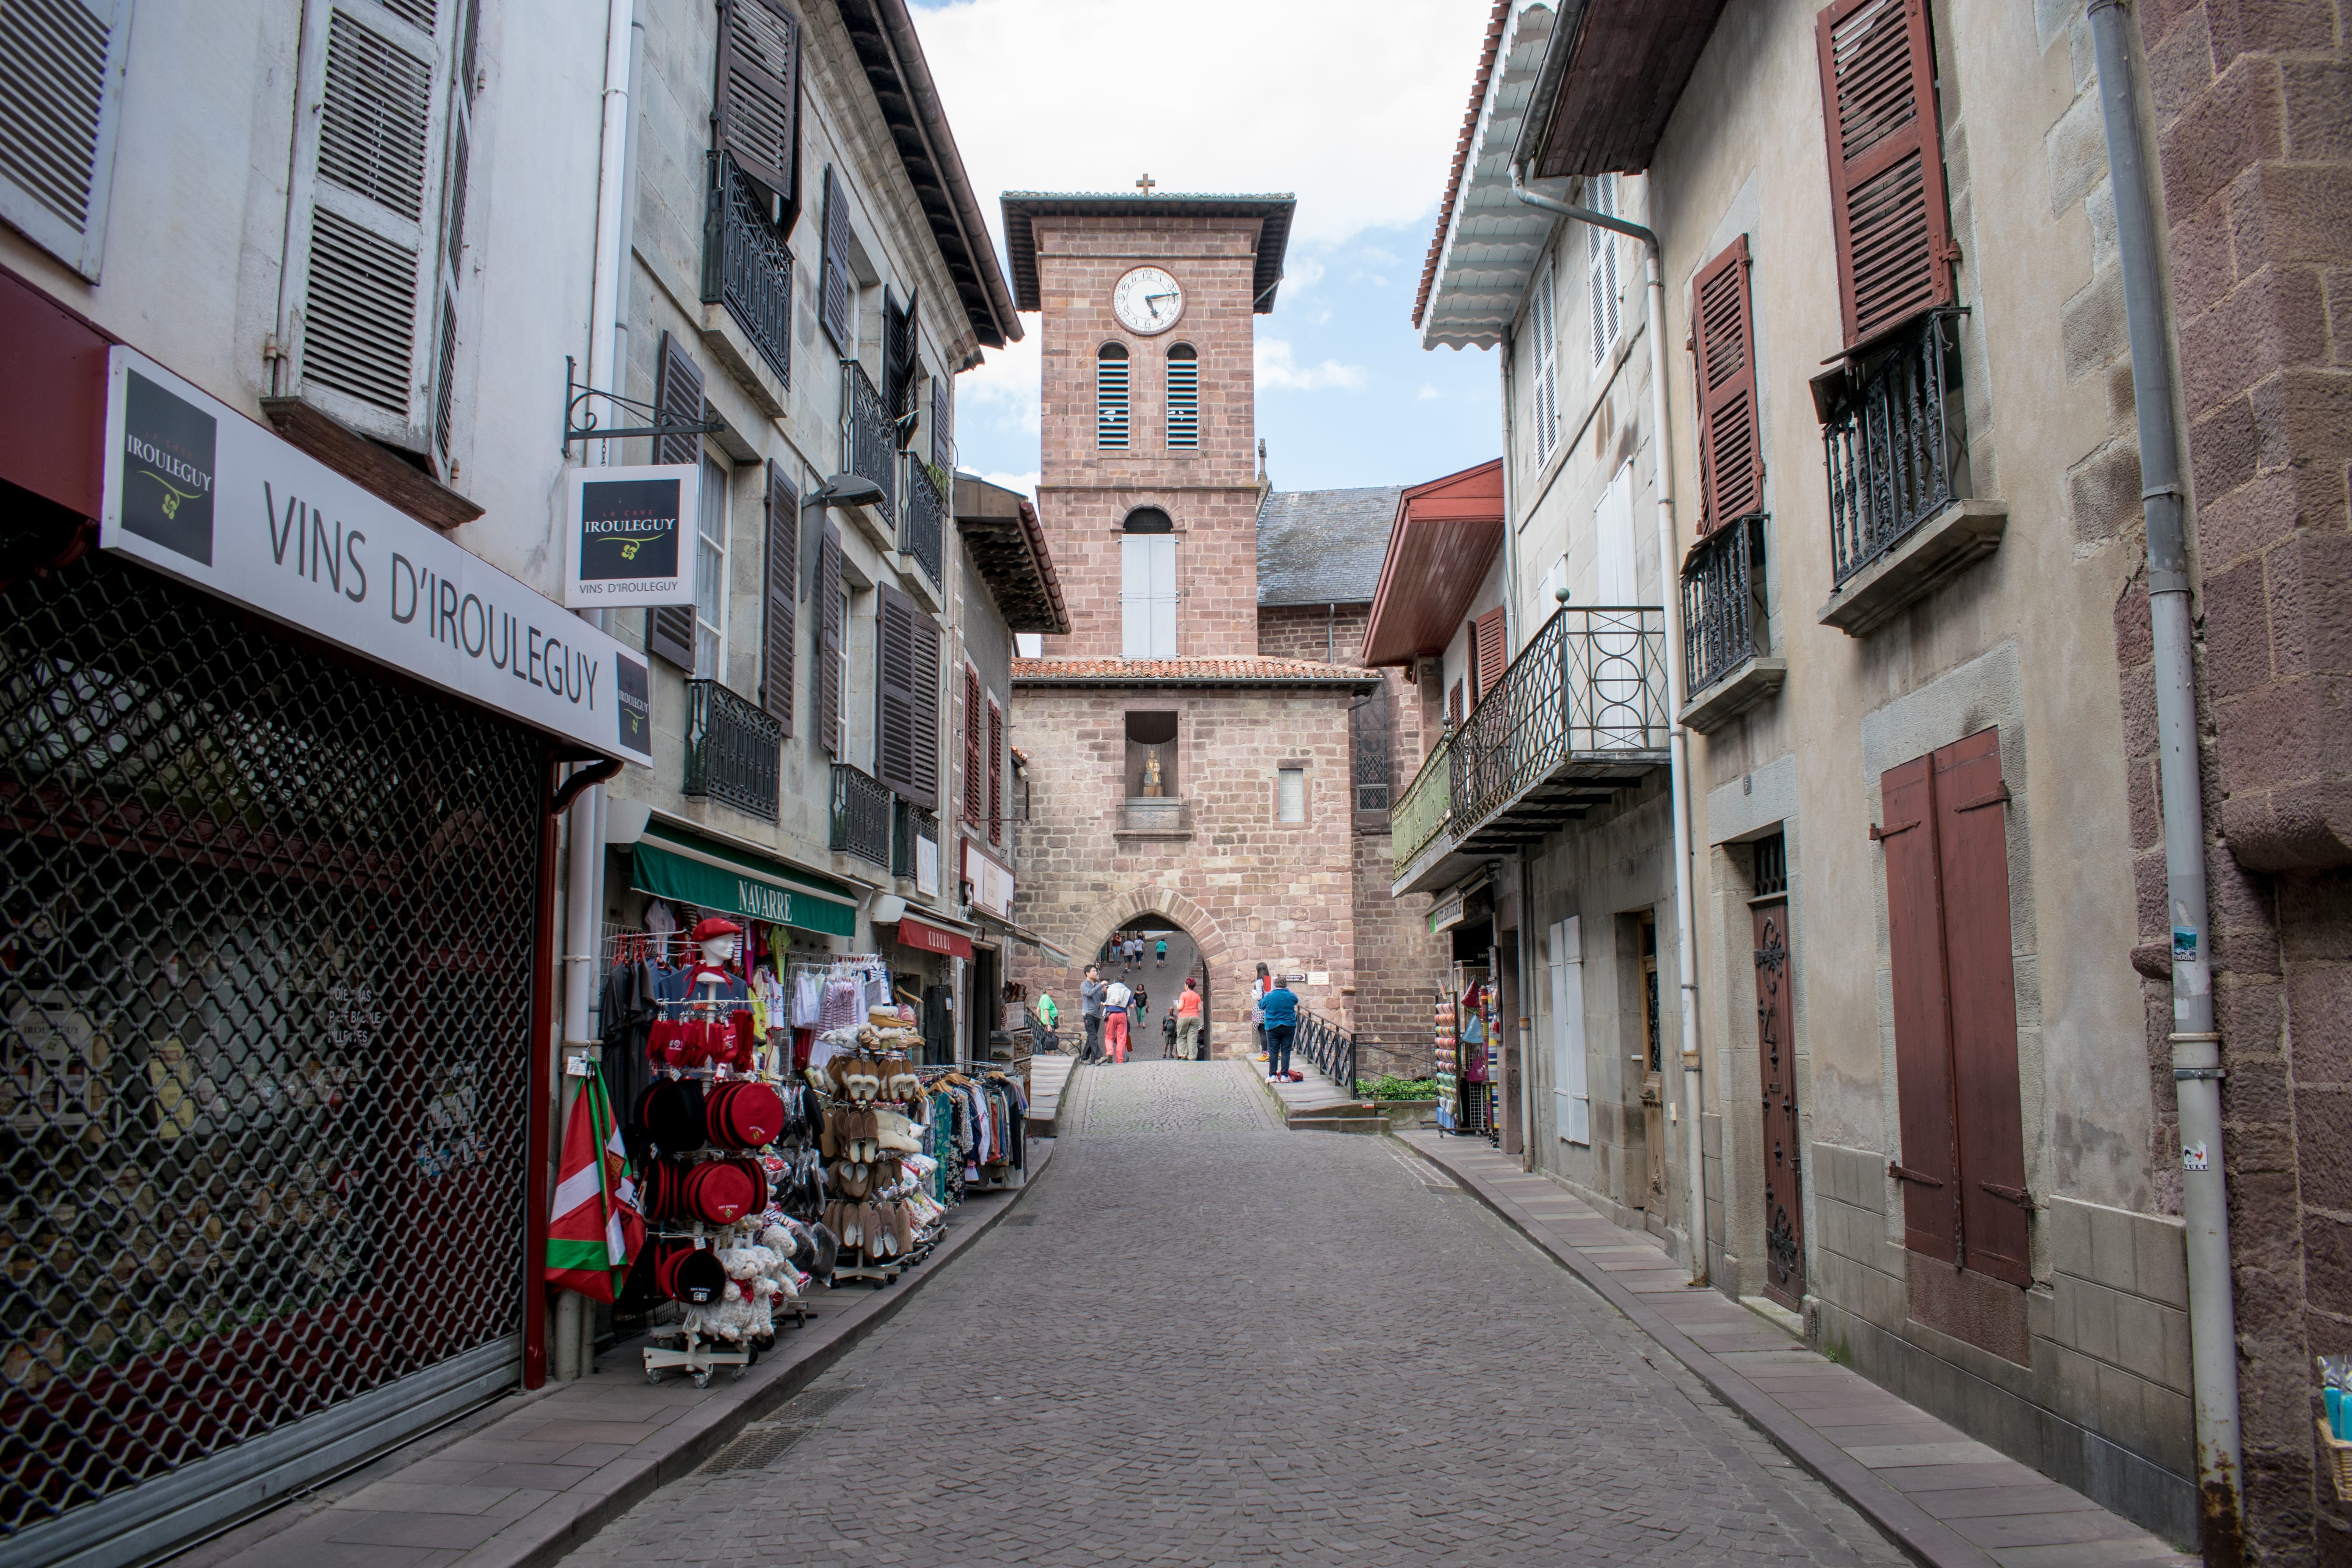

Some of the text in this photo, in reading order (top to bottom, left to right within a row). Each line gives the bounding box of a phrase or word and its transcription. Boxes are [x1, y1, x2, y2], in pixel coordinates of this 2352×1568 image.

[1131, 270, 1136, 283] 11
[1143, 270, 1153, 279] 12
[1121, 282, 1129, 290] 10
[1167, 283, 1174, 293] 2
[1118, 294, 1125, 304] 9
[1123, 306, 1129, 316] 8
[1144, 319, 1151, 328] 6
[127, 433, 213, 492] IROULEGUY
[584, 518, 676, 534] IROULEGUY
[579, 581, 679, 594] VINS D'IROULEGUY
[263, 480, 598, 711] VINS D'IROULEGUY
[618, 690, 648, 713] IROULEGUY
[738, 880, 792, 922] NAVARRE
[928, 931, 950, 950] KUXKUL
[330, 987, 348, 1001] OIE
[329, 1010, 348, 1023] PE
[24, 1025, 80, 1034] IROUGUY
